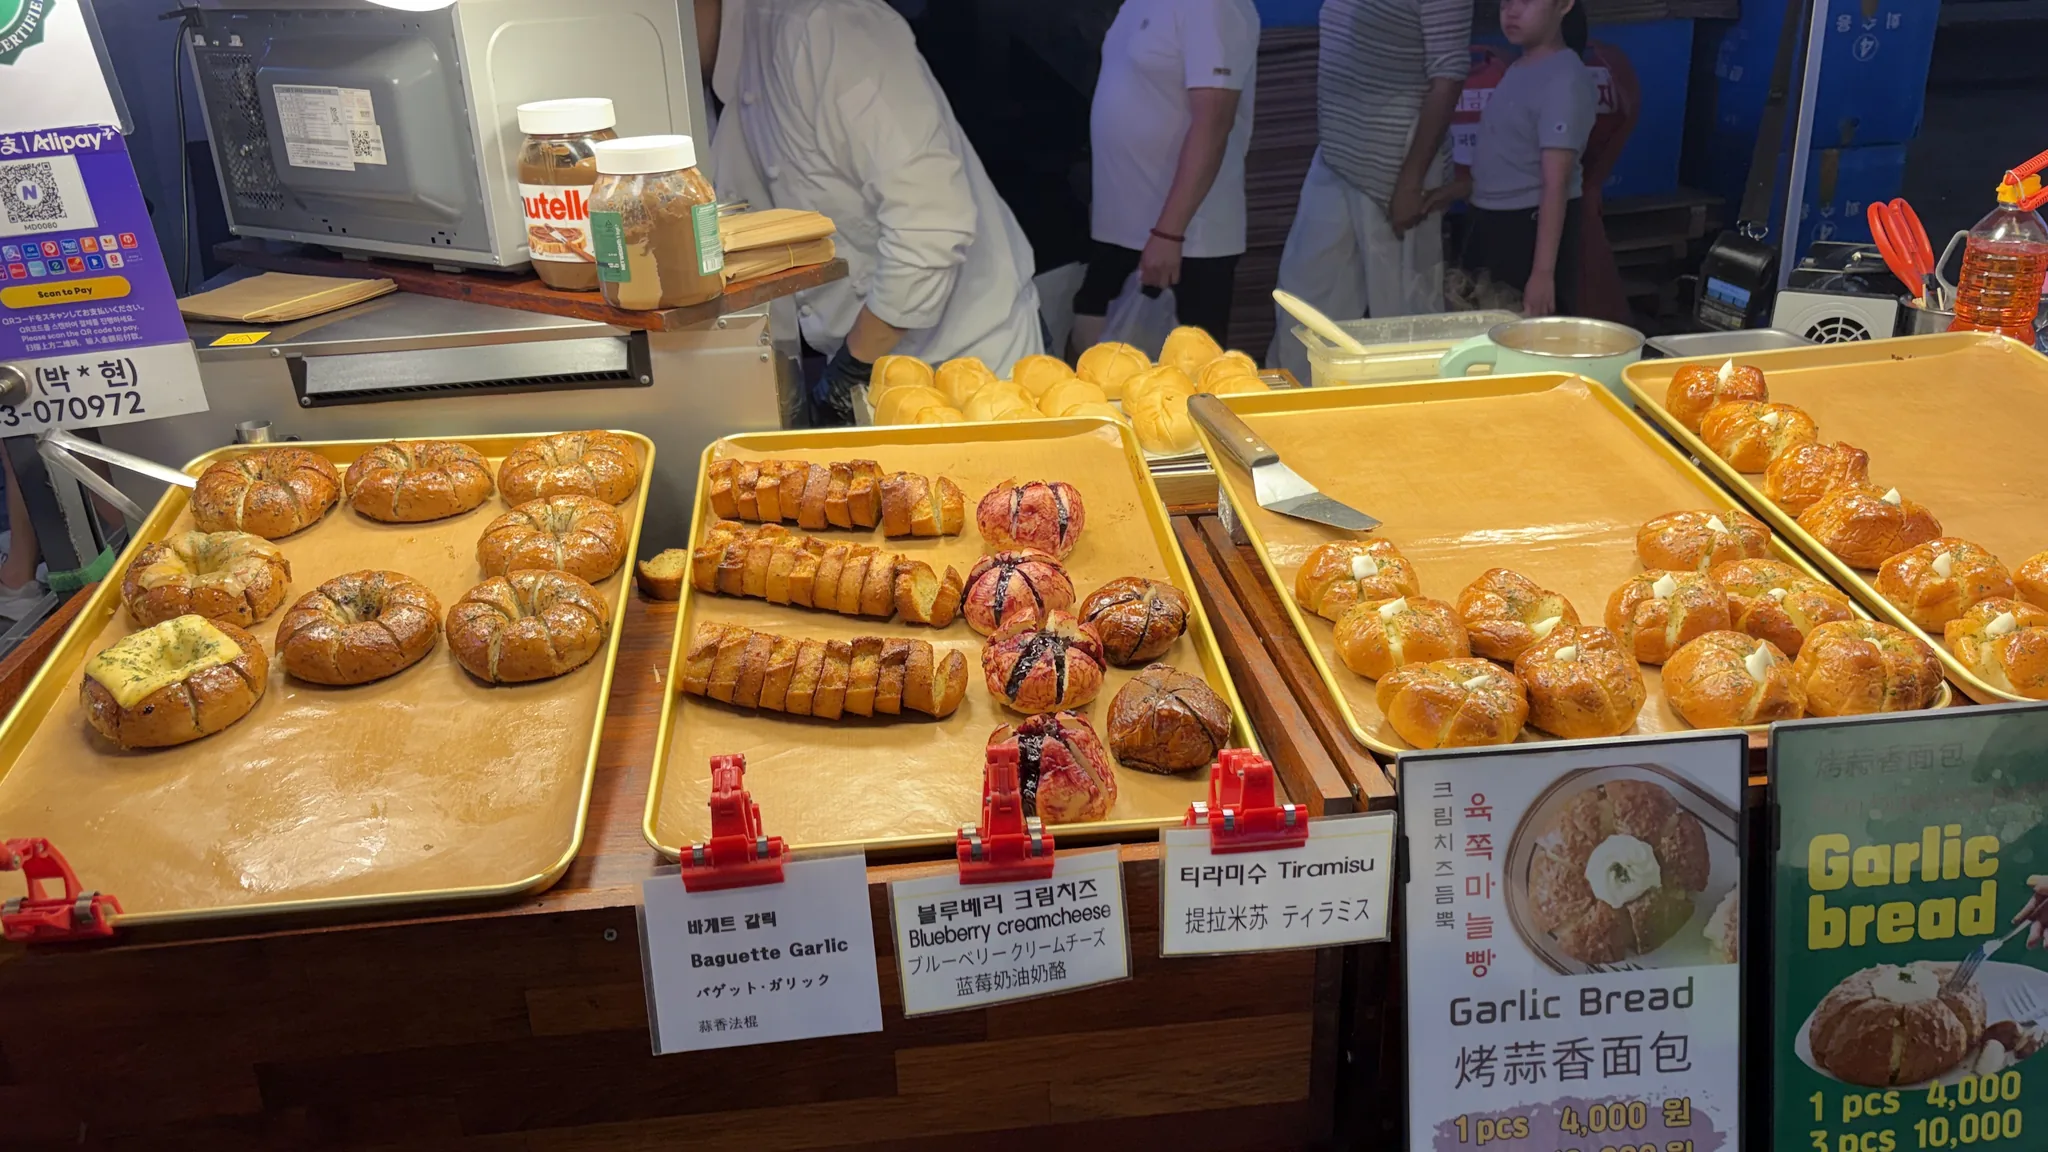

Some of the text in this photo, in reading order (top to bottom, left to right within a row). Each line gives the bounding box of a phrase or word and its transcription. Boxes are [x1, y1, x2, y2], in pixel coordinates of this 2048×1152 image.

[37, 287, 92, 299] Scan to Pay
[21, 335, 46, 343] Please
[80, 328, 92, 336] QR
[93, 326, 112, 335] code
[1180, 856, 1374, 888] 티라미수 Tiramisu
[1433, 782, 1455, 930] 크림치즈듬뿍
[1808, 824, 2000, 891] Garlic
[918, 879, 1098, 925] 블루베리 크림치즈
[1463, 792, 1496, 978] 육쪽마늘빵
[687, 911, 777, 935] 바게트 갈릭
[909, 904, 1111, 948] Blueberry creamcheese
[1185, 899, 1369, 934] 提拉米苏 ティラミス
[1808, 880, 1997, 950] bread
[691, 938, 848, 968] Baguette Garlic
[955, 960, 1067, 997] 蓝莓奶油奶酪
[1450, 976, 1693, 1026] Garlic Bread
[699, 1015, 758, 1033] 蒜香法棍
[1454, 1030, 1692, 1089] 烤蒜香面包
[1809, 1071, 2021, 1123] 1 pcs 4,000
[1454, 1097, 1691, 1145] 1 pcs 4,000 원
[1913, 1108, 2022, 1148] 10,000
